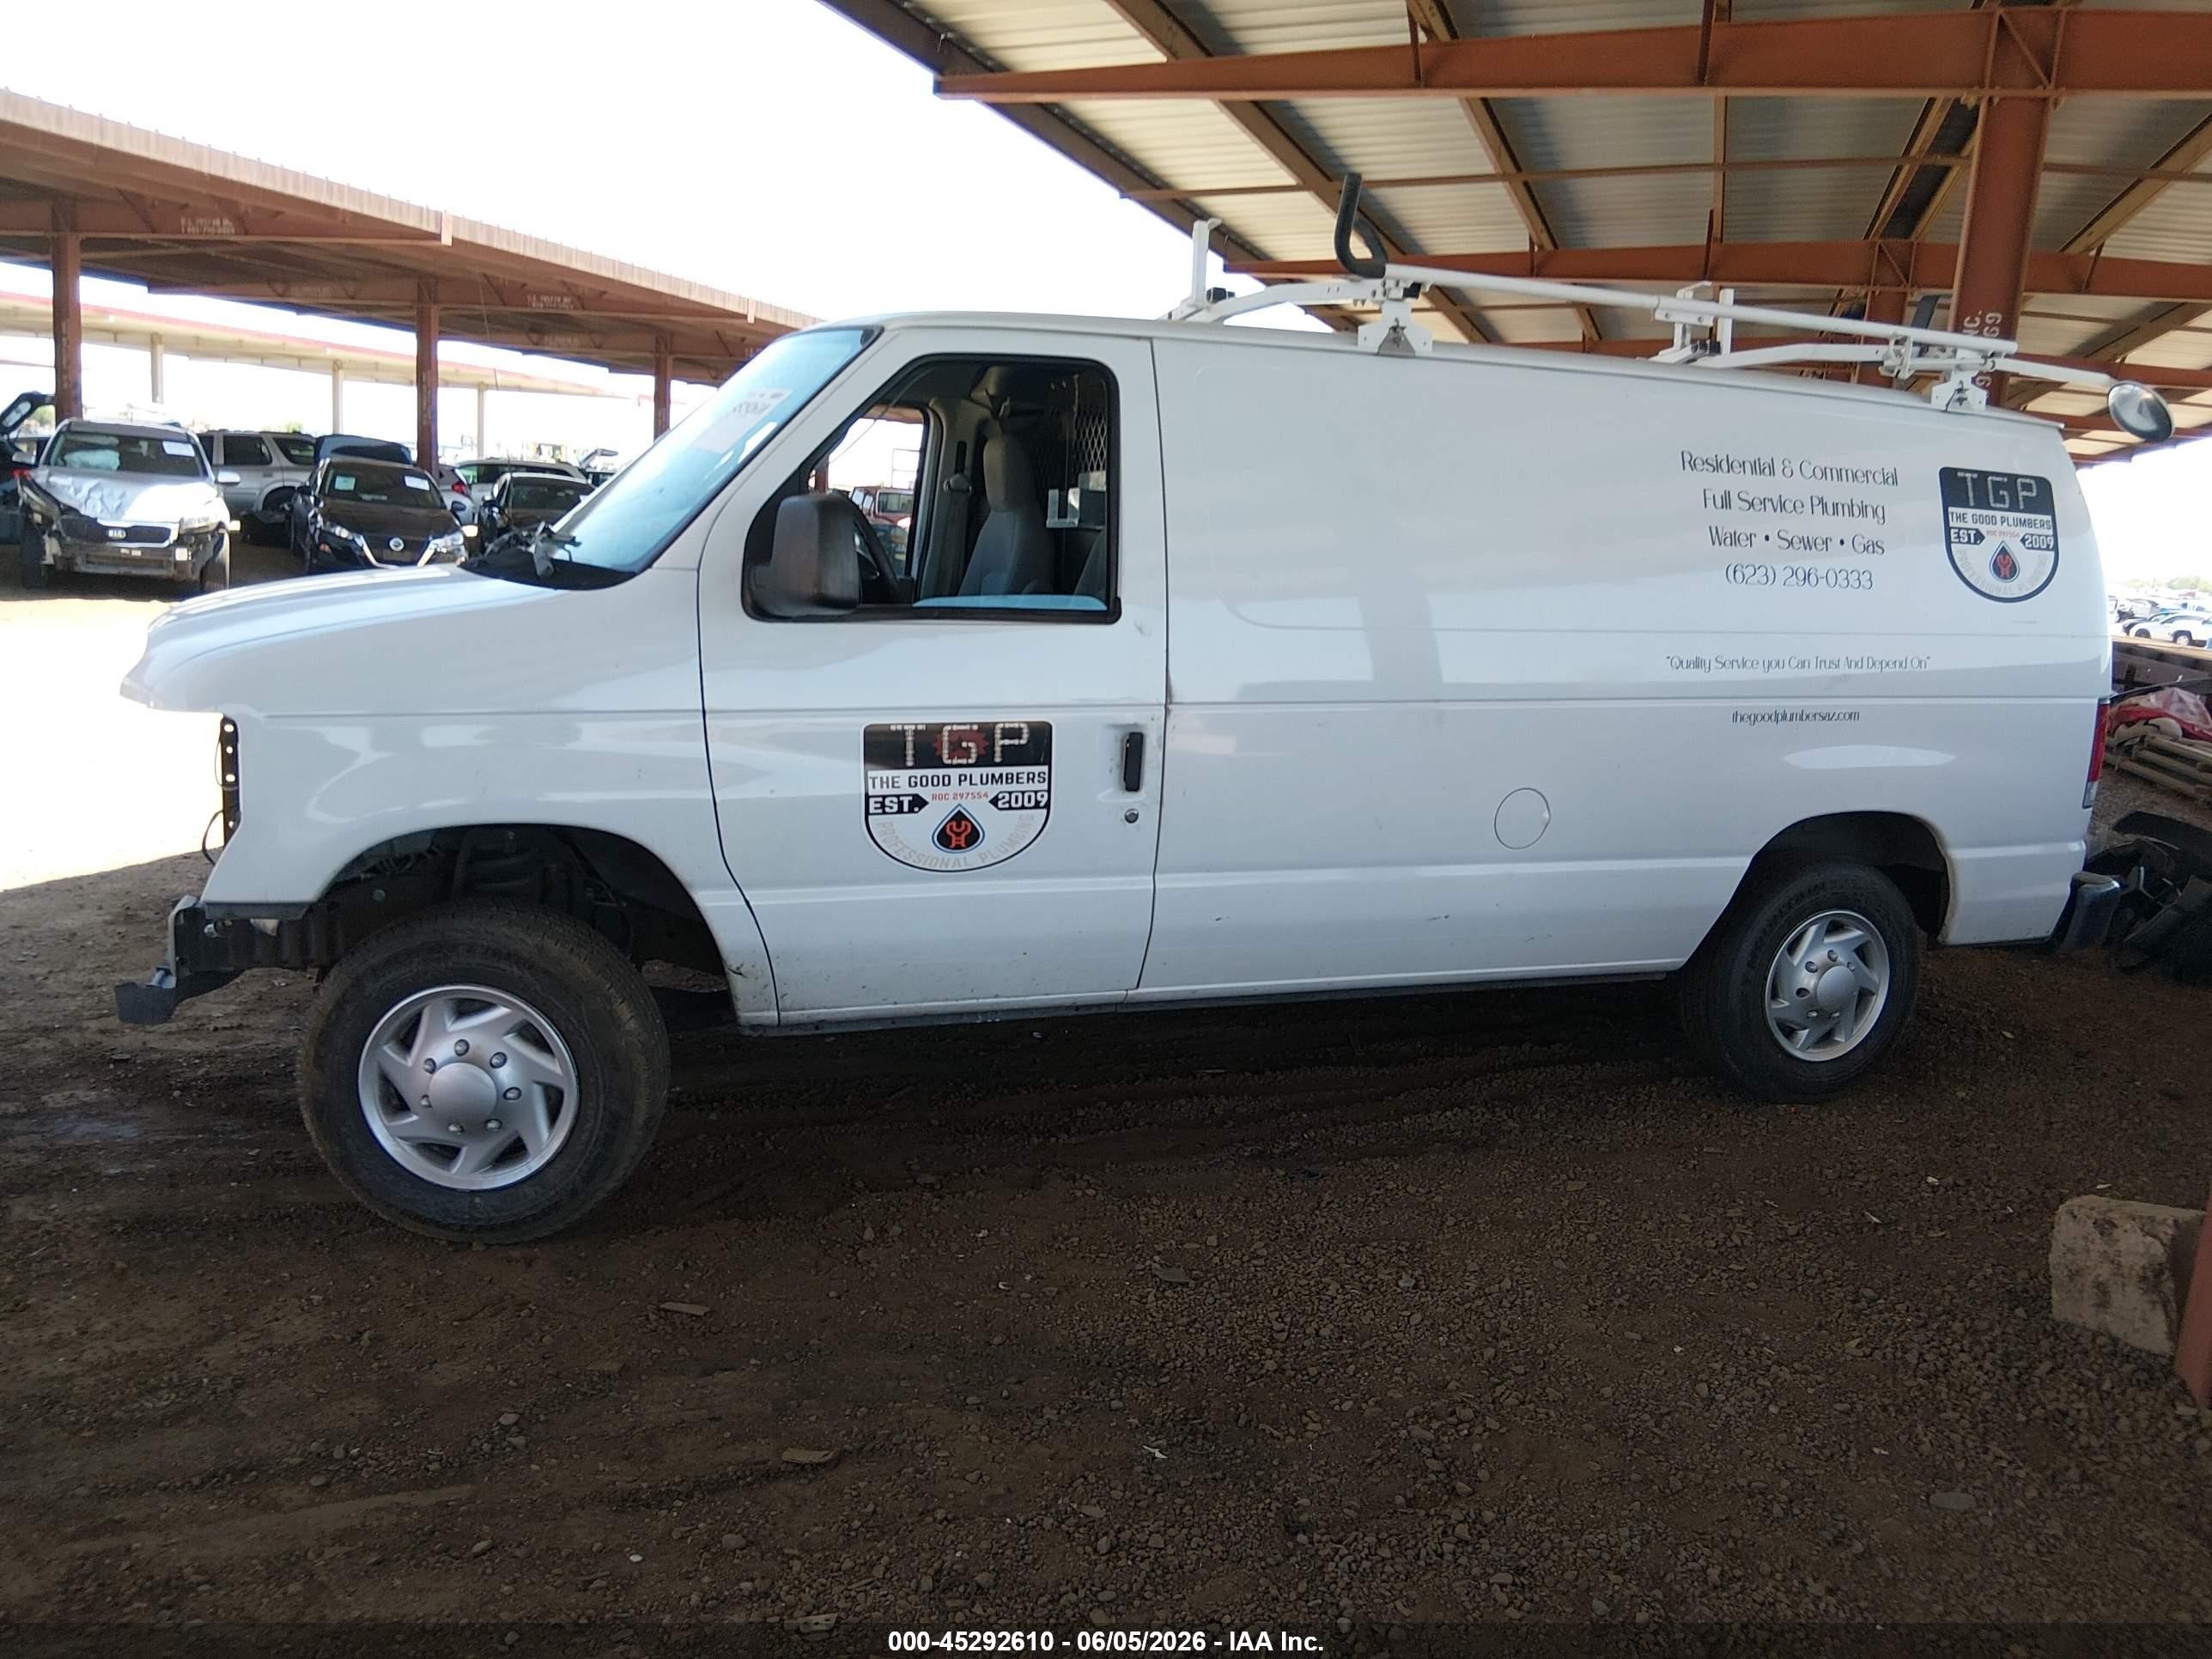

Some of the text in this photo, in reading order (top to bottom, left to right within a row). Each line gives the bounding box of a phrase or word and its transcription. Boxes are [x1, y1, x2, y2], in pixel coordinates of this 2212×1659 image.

[1680, 450, 1899, 487] Residential & Commercial
[1957, 471, 2037, 510] TGP
[1703, 488, 1886, 526] Full Service Plumbing
[1949, 511, 2051, 531] THE GOOD PLUMBERS
[1709, 526, 1886, 556] Water Sewer Gas
[1951, 528, 1981, 544] EST.
[2024, 535, 2054, 550] 2009
[1725, 563, 1873, 590] (623) 296-0333
[1715, 655, 1759, 670] Service
[1762, 658, 1784, 673] you
[1788, 656, 1810, 670] Can
[1814, 655, 1840, 670] Trust
[1844, 655, 1863, 670] And
[1866, 655, 1907, 672] Depend
[1732, 709, 1860, 726] thegoodplumbersaz.com
[890, 722, 1030, 767] TGP
[869, 771, 1047, 789] THE GOOD PLUMBERS
[868, 795, 921, 814] EST.
[952, 791, 989, 801] 297554
[997, 791, 1048, 809] 2009
[877, 814, 1035, 870] PROFESSIONAL PLUMBING
